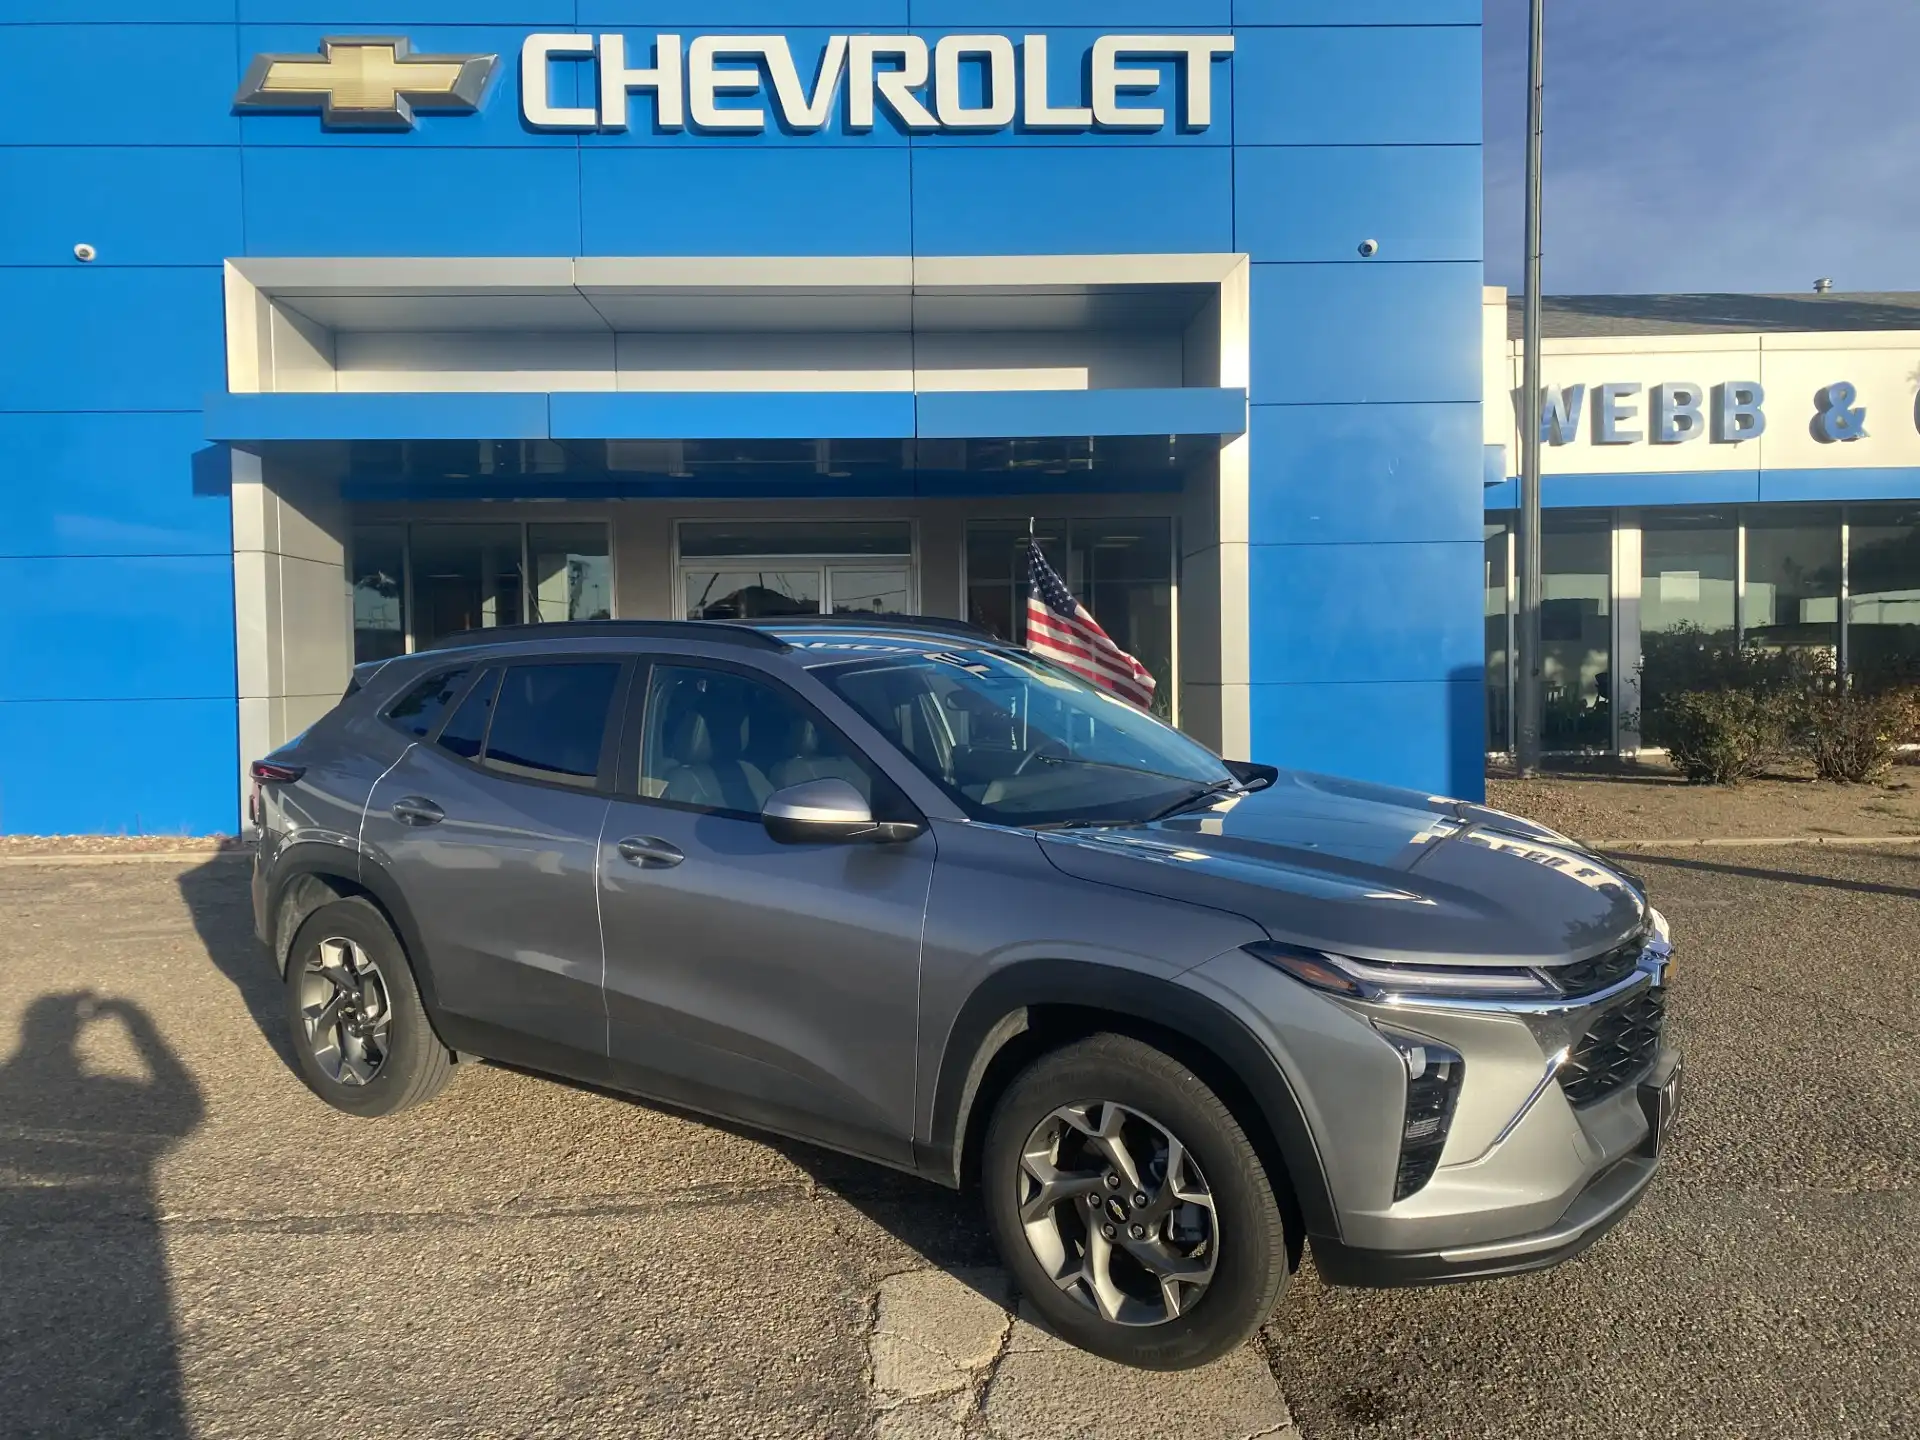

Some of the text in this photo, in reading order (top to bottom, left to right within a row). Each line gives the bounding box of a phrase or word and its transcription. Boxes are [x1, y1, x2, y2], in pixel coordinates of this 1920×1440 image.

[521, 33, 1235, 131] CHEVROLET
[1509, 381, 1766, 446] WEBB
[1808, 381, 1870, 444] &
